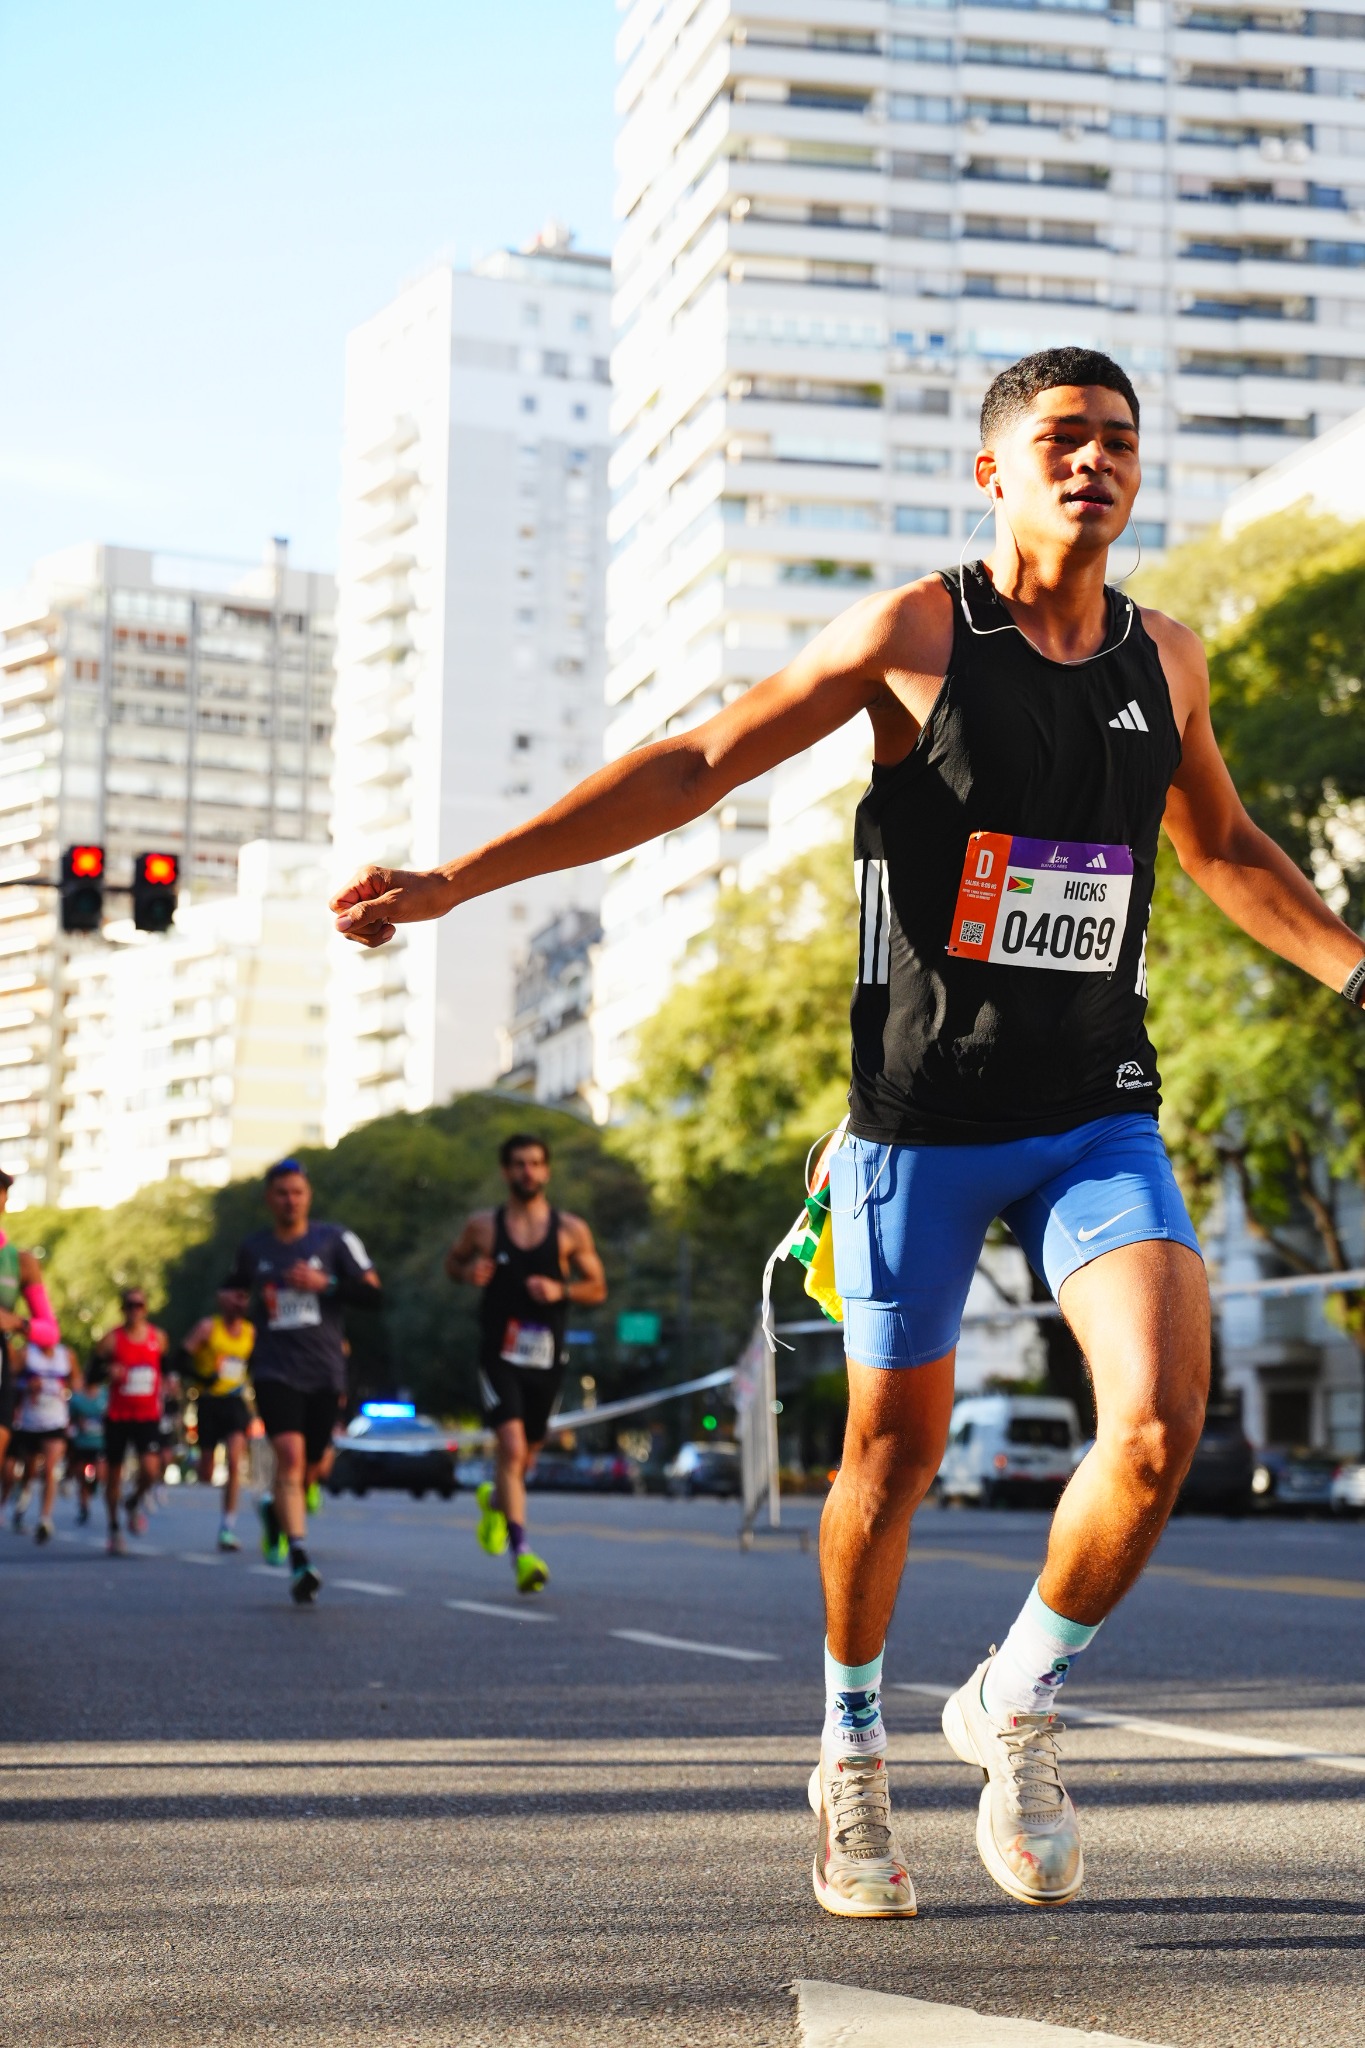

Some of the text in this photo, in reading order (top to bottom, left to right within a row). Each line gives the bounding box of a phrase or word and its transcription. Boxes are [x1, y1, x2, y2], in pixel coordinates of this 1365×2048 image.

[975, 849, 994, 879] D
[1054, 856, 1069, 864] 21K
[1063, 880, 1107, 902] HICKS
[1001, 910, 1116, 961] 04069
